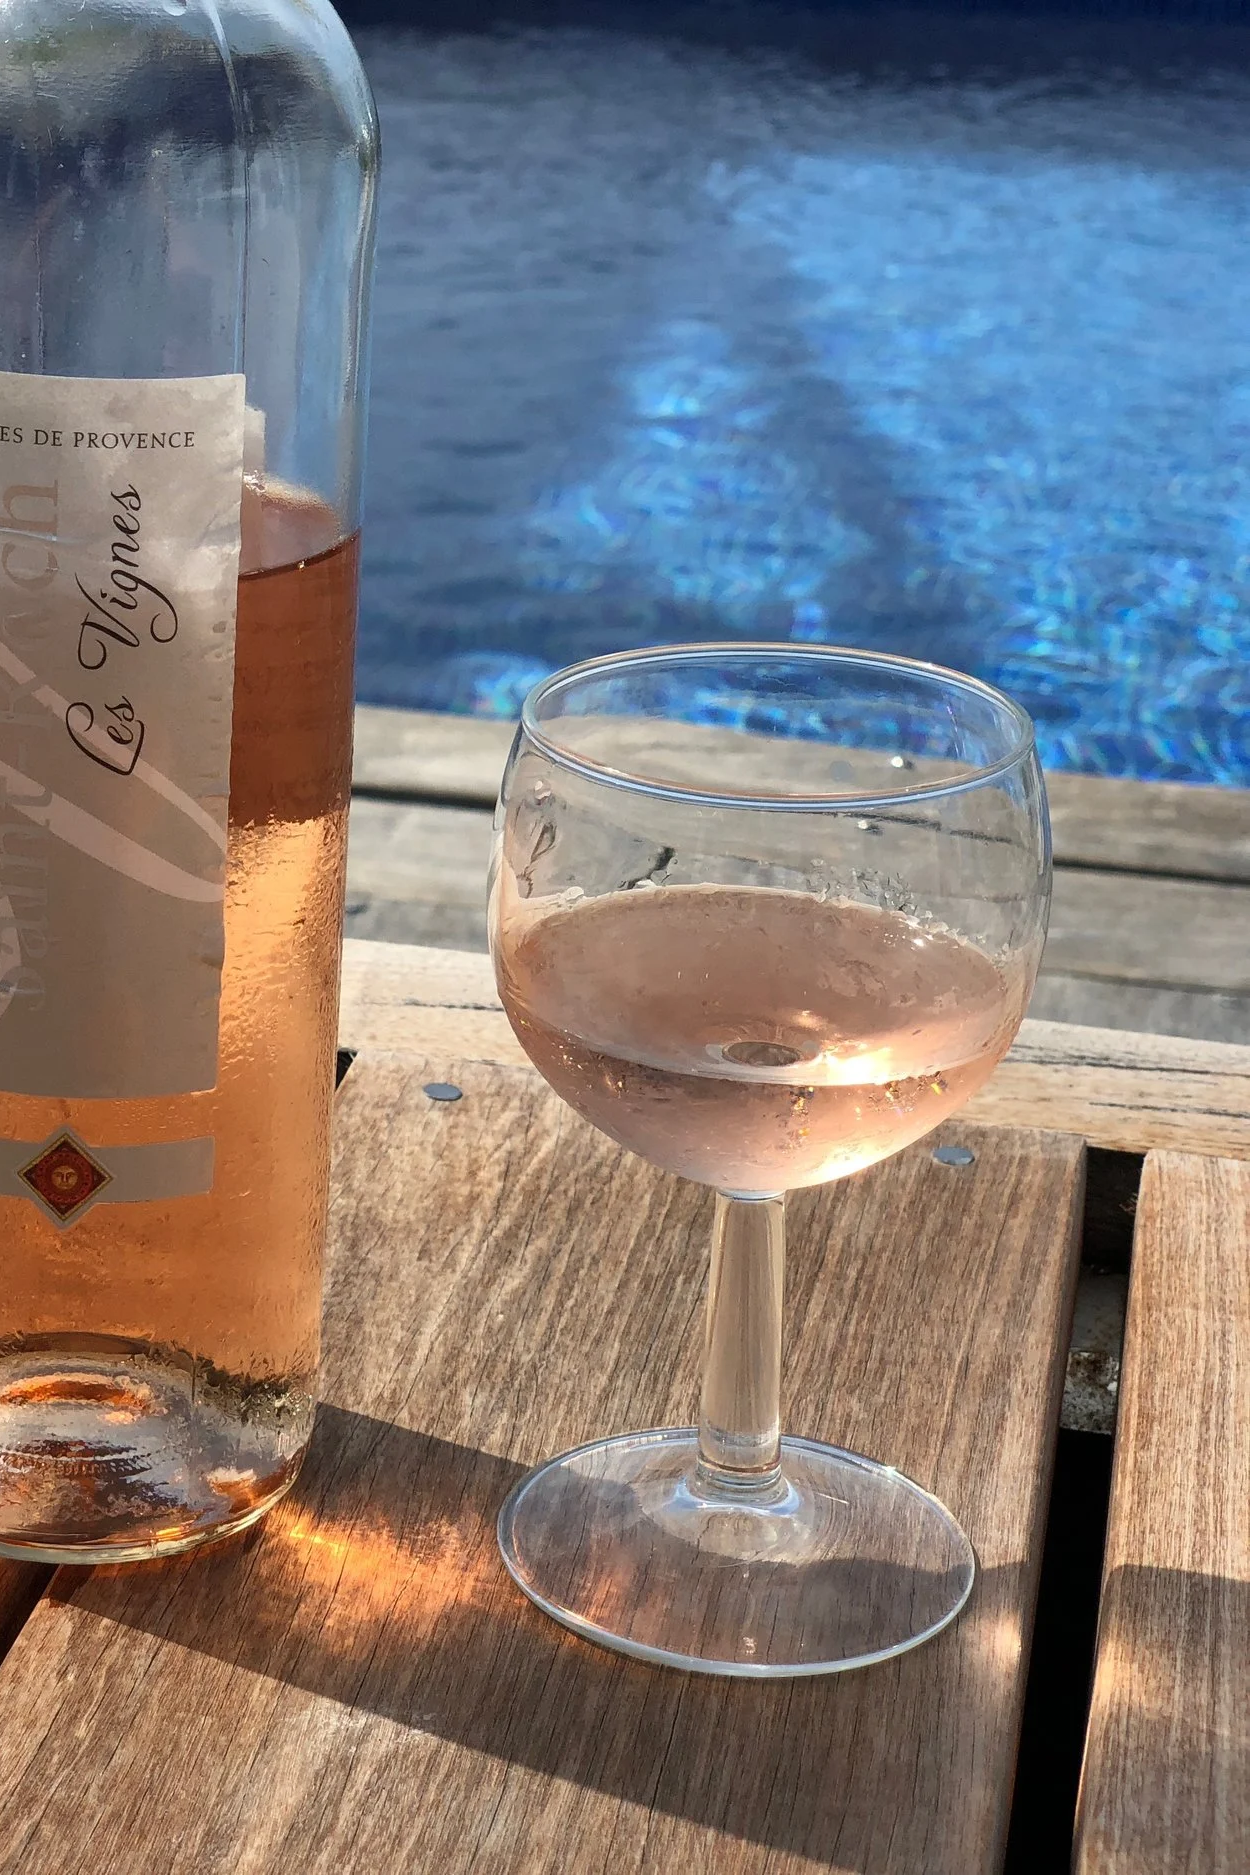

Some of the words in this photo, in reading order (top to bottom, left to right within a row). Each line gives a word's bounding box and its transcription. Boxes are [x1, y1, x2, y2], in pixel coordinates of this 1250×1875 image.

[33, 428, 63, 447] DE
[72, 431, 196, 449] PROVENCE
[74, 483, 178, 670] Vignes
[65, 695, 145, 775] Les
